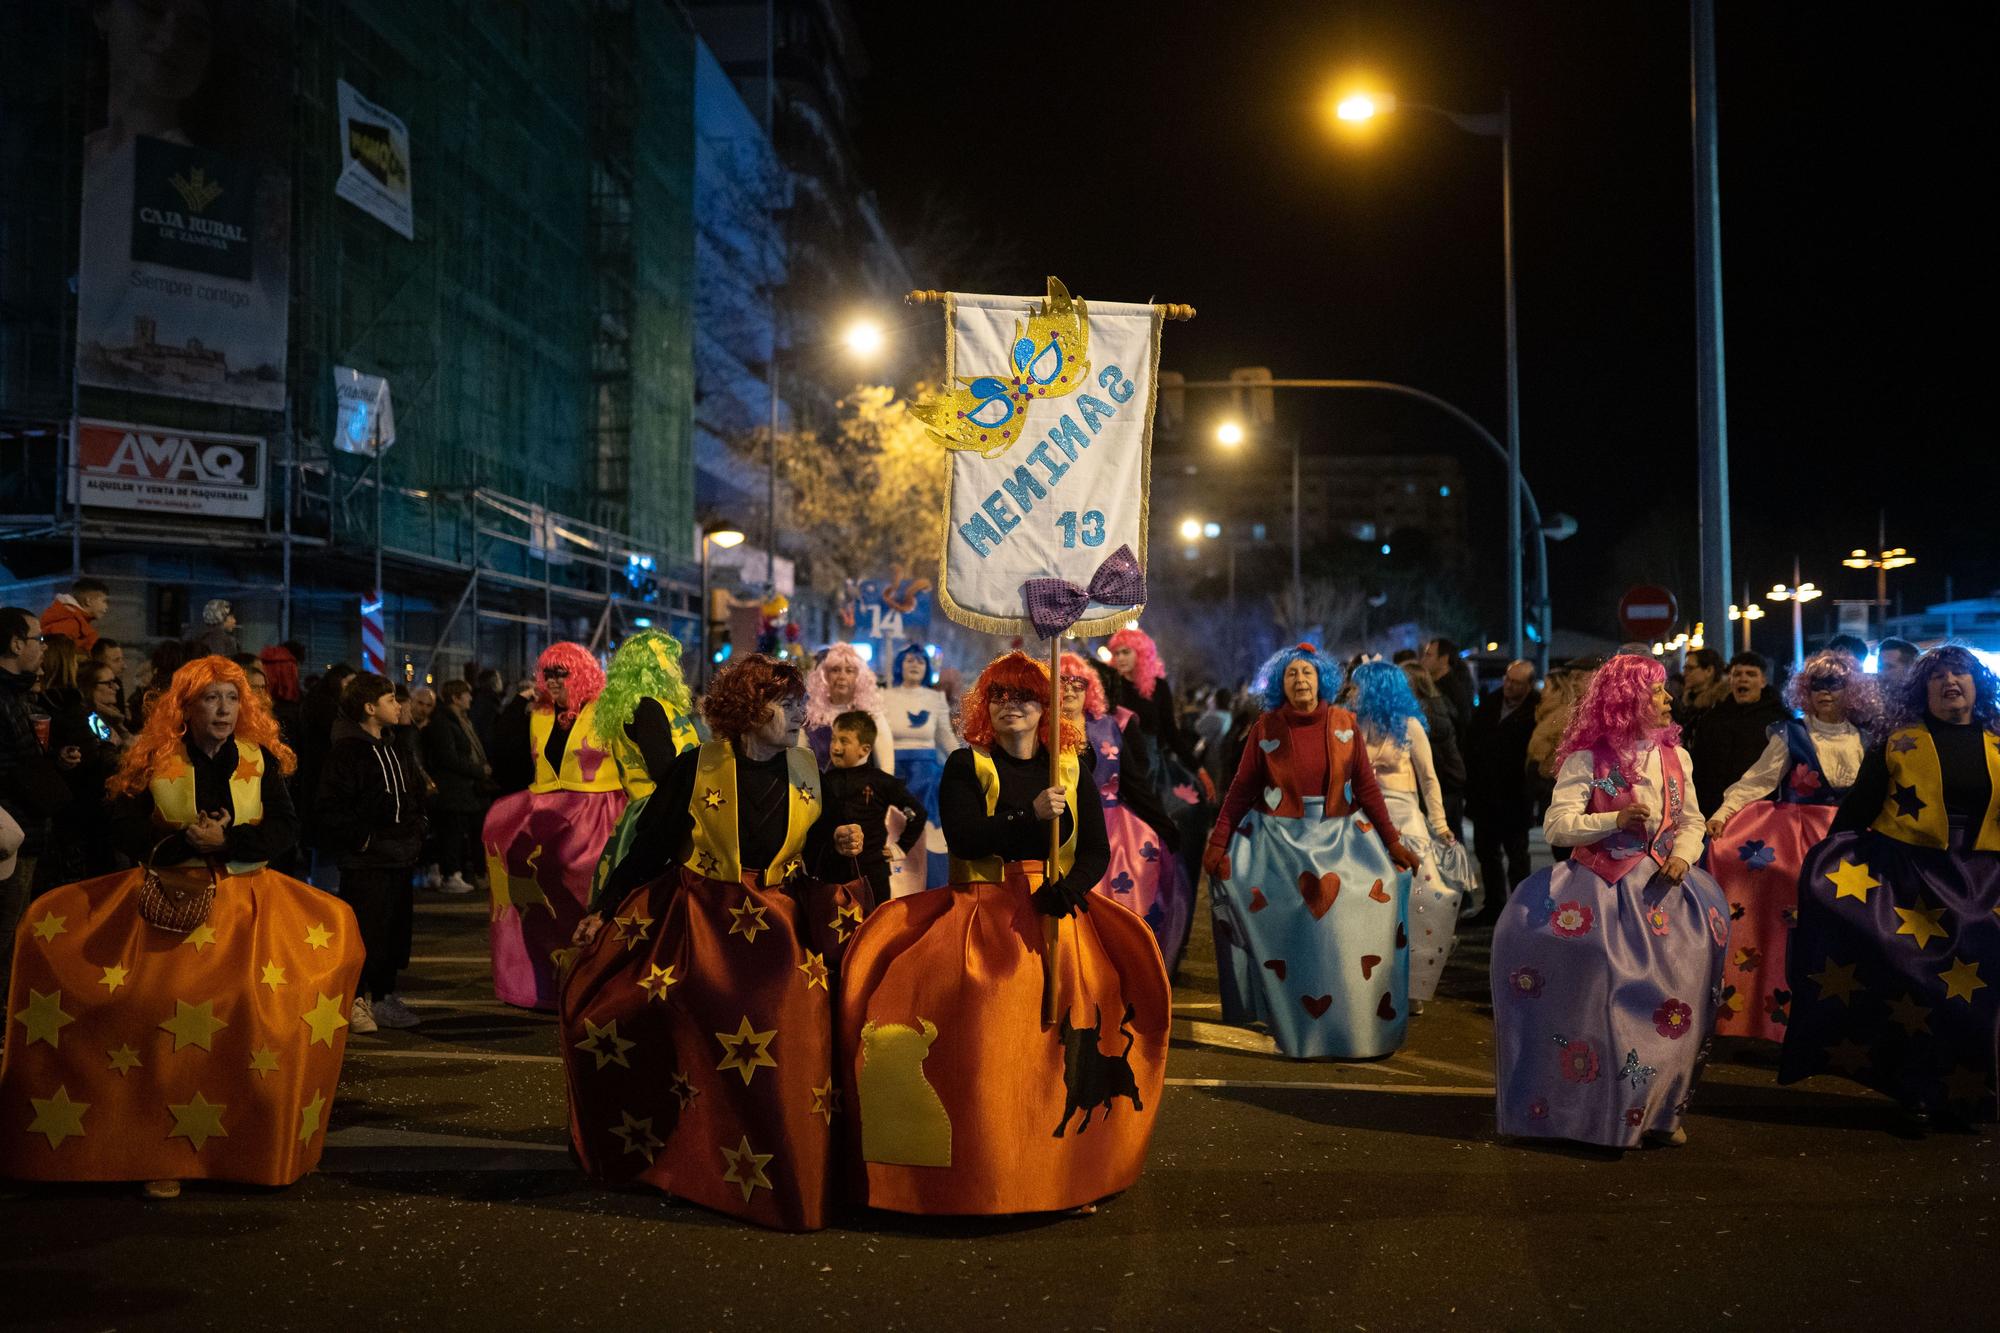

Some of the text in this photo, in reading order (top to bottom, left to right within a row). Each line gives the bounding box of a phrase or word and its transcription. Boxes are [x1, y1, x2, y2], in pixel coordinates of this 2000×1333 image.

[139, 207, 248, 242] CAJA RURAL
[160, 227, 228, 251] DE ZAMORA
[131, 271, 250, 310] Siempre contigo
[86, 431, 245, 485] AMAQ
[87, 479, 249, 502] ALQUILER Y VENTA DE MAQUINARIA
[1056, 510, 1106, 548] 13
[859, 604, 906, 639] 14
